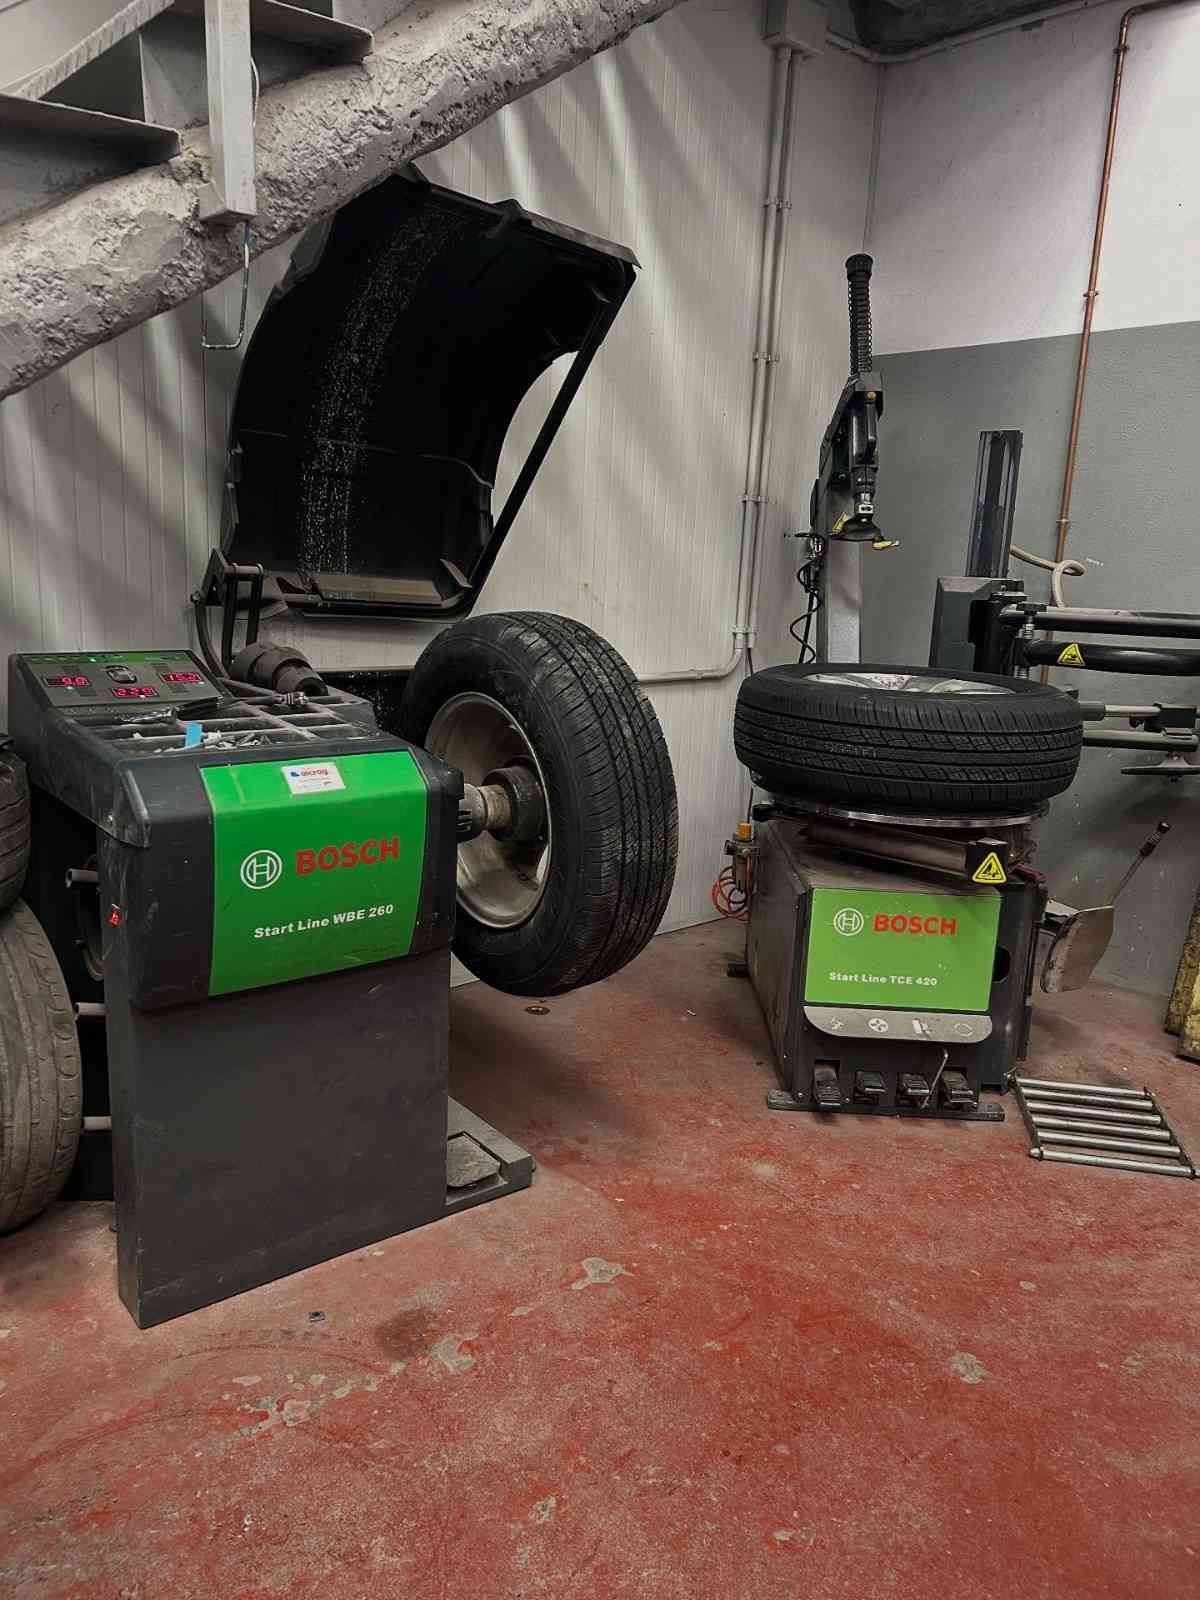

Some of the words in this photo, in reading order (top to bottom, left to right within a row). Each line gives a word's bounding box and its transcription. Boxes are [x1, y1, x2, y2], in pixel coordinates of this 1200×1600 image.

[295, 836, 399, 876] BOSCH
[254, 923, 294, 939] Start
[297, 918, 330, 931] Line
[333, 909, 366, 925] WBE
[368, 904, 394, 919] 260
[873, 913, 957, 936] BOSCH
[829, 972, 859, 982] Start
[861, 973, 888, 984] Line
[889, 975, 913, 985] TCE
[915, 977, 938, 986] 420
